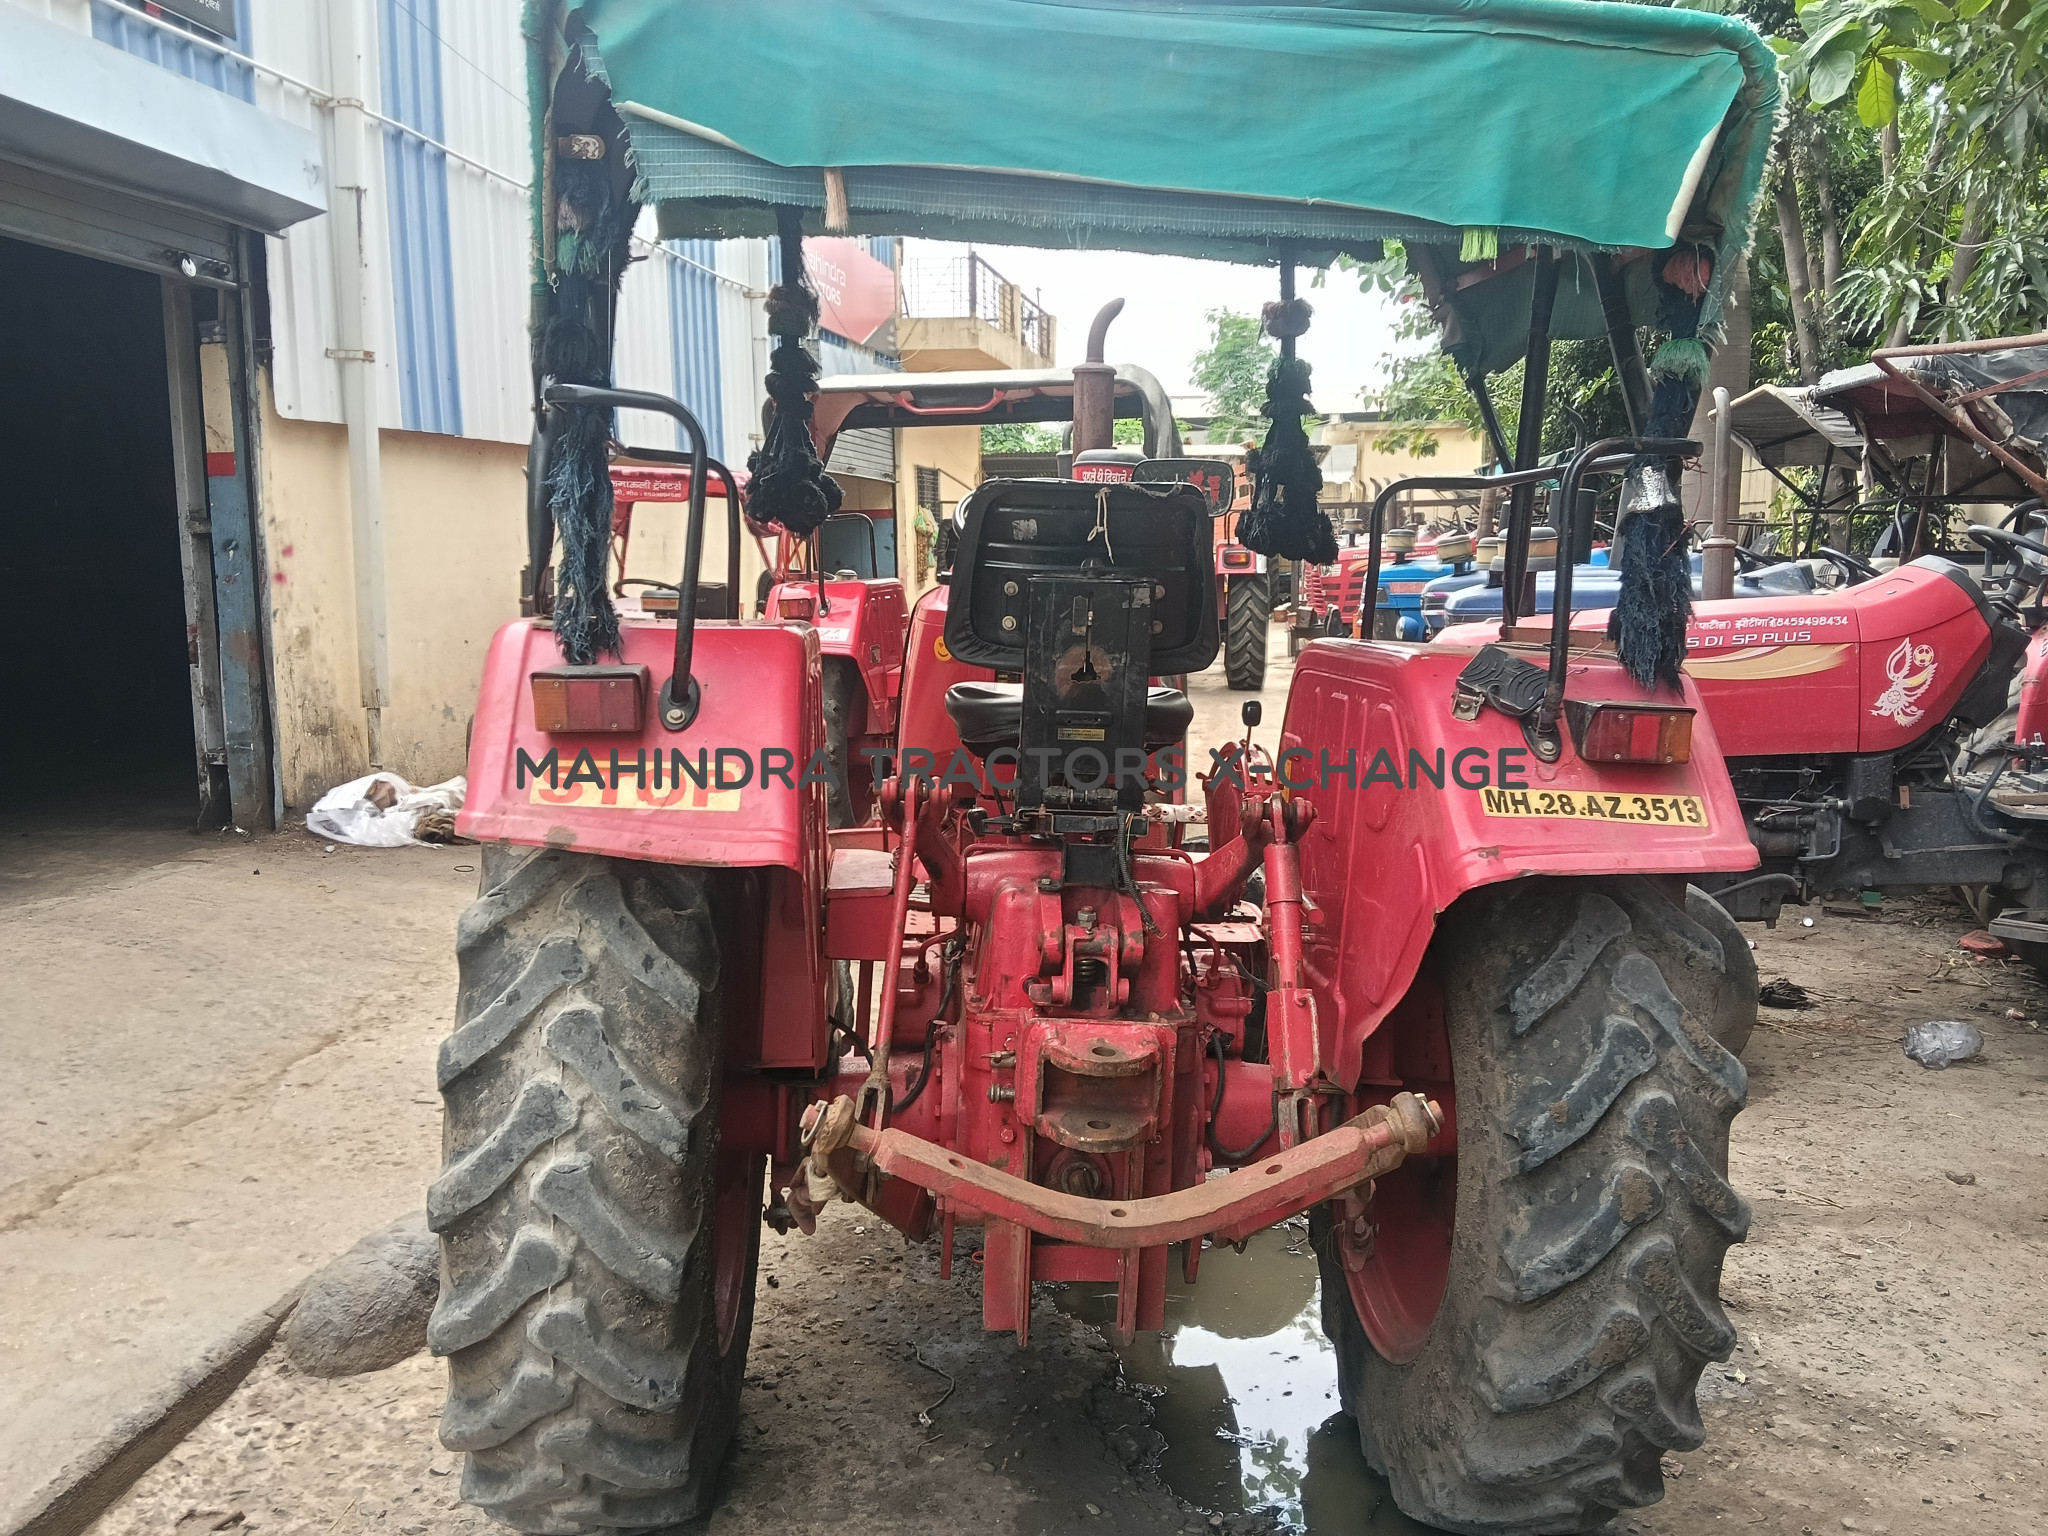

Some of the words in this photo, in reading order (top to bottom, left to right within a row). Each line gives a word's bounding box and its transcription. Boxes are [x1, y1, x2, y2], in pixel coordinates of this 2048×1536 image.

[808, 249, 846, 288] ahindra
[1705, 636, 1724, 647] DI
[1732, 634, 1758, 645] SP
[1762, 631, 1811, 643] PLUS
[538, 766, 736, 808] STOP
